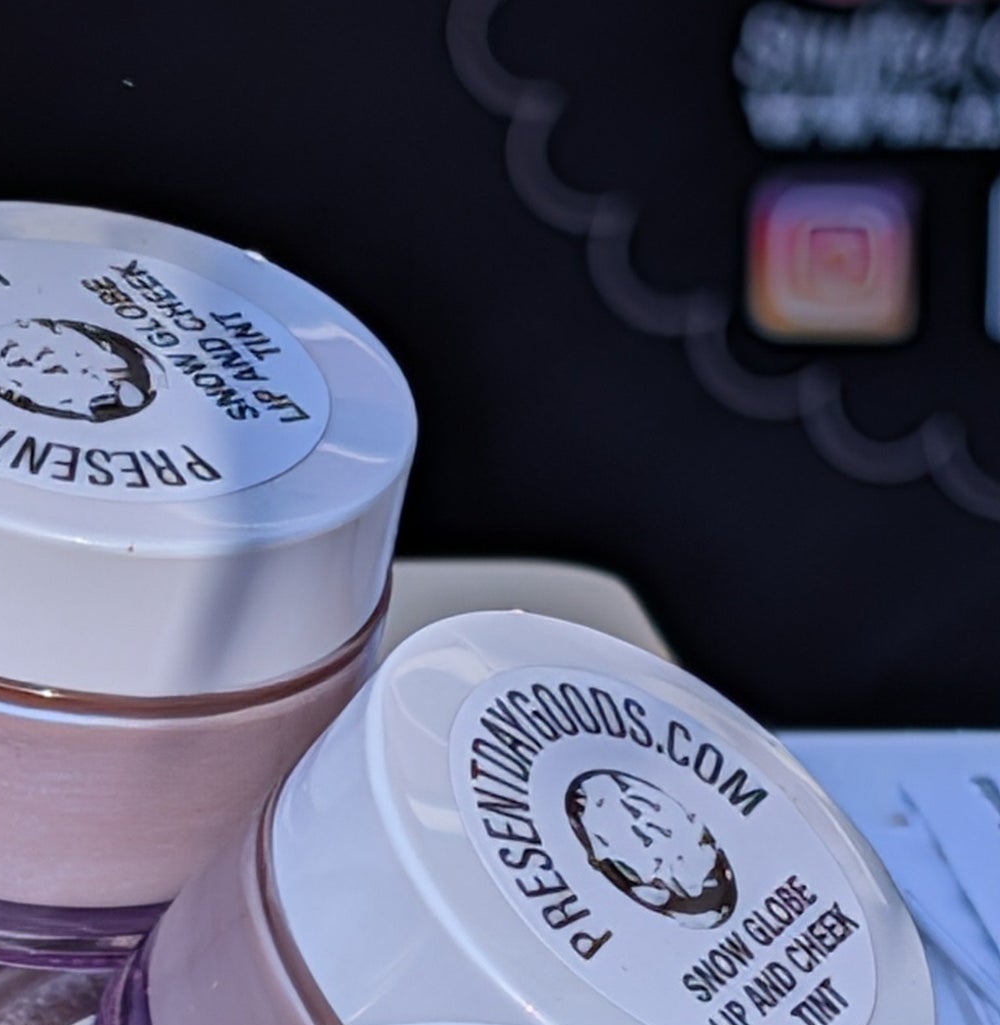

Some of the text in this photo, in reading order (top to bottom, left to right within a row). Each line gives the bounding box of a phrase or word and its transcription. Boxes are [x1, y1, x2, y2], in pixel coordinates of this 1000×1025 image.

[80, 276, 260, 421] SNOW GLOBE
[109, 259, 311, 424] LIP AND CHEEK
[209, 311, 281, 361] TINT
[471, 682, 769, 961] PRESENTDAYGOODS.COM
[682, 874, 819, 1003] SNOW GLOBE
[754, 962, 797, 1018] AND
[788, 901, 861, 974] CHEEK
